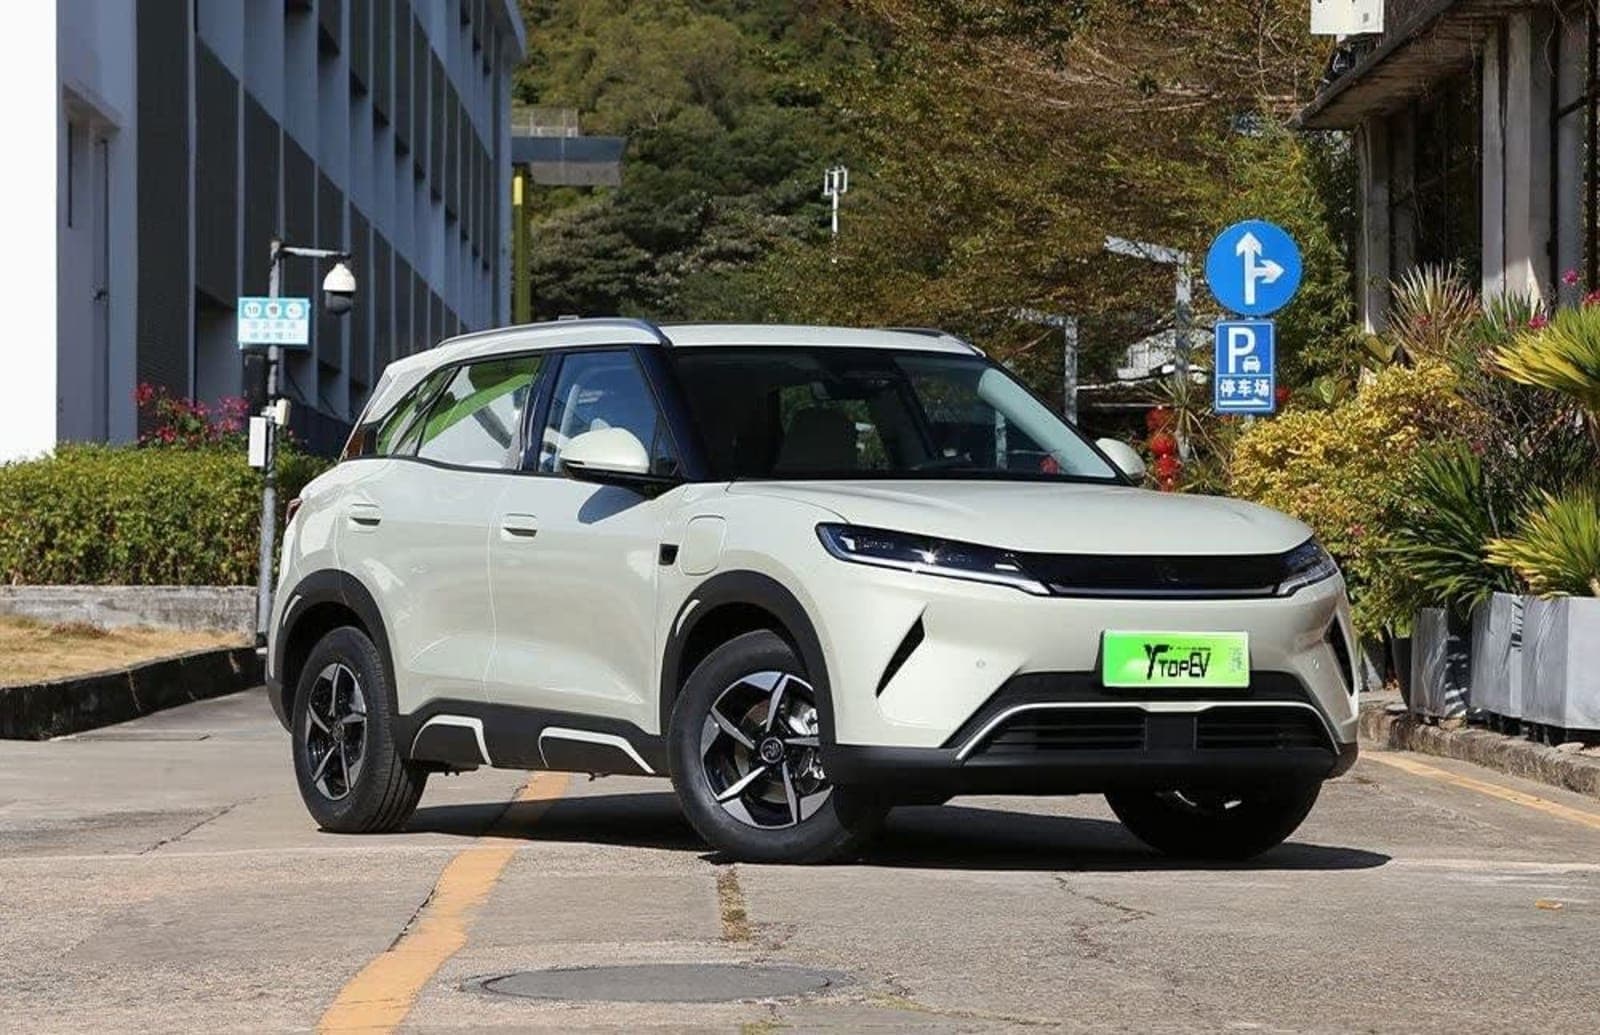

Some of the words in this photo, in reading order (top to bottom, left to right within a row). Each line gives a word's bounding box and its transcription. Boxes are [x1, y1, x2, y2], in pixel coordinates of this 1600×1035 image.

[1228, 327, 1256, 374] P
[1220, 379, 1270, 398] 停车场
